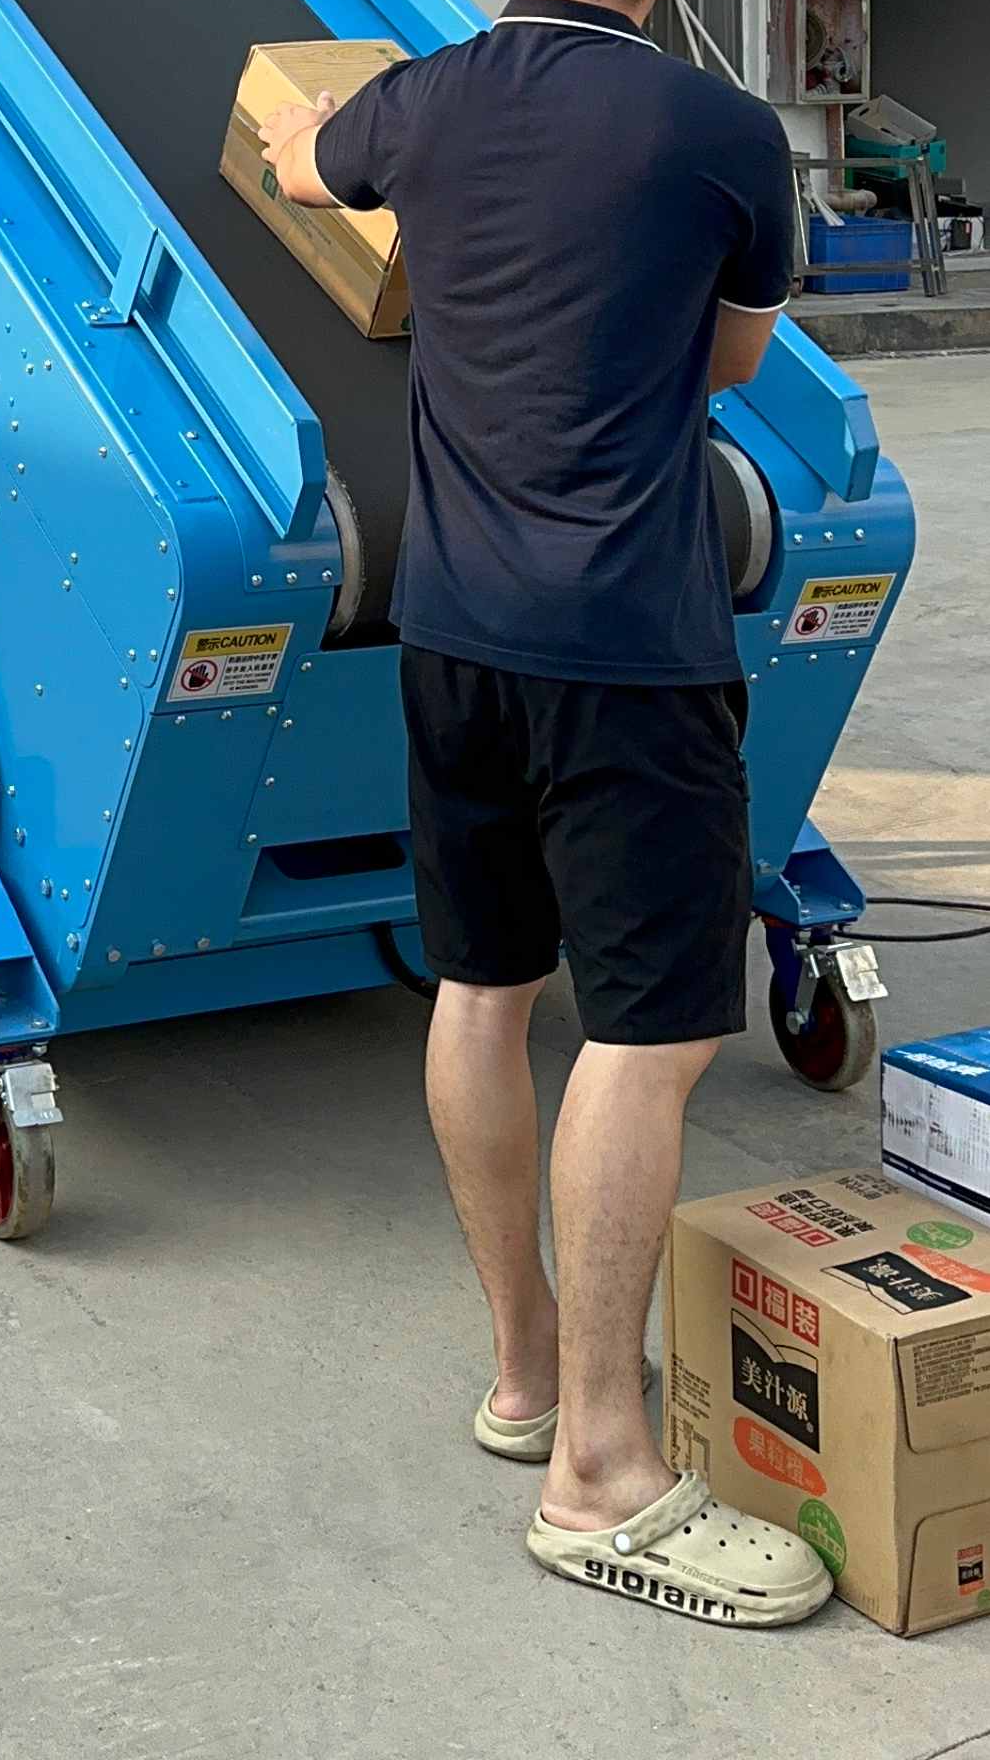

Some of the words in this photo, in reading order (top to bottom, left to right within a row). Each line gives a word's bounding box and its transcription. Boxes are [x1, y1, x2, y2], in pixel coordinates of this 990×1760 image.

[733, 1258, 819, 1345] 口福装
[739, 1355, 808, 1421] 美汁源
